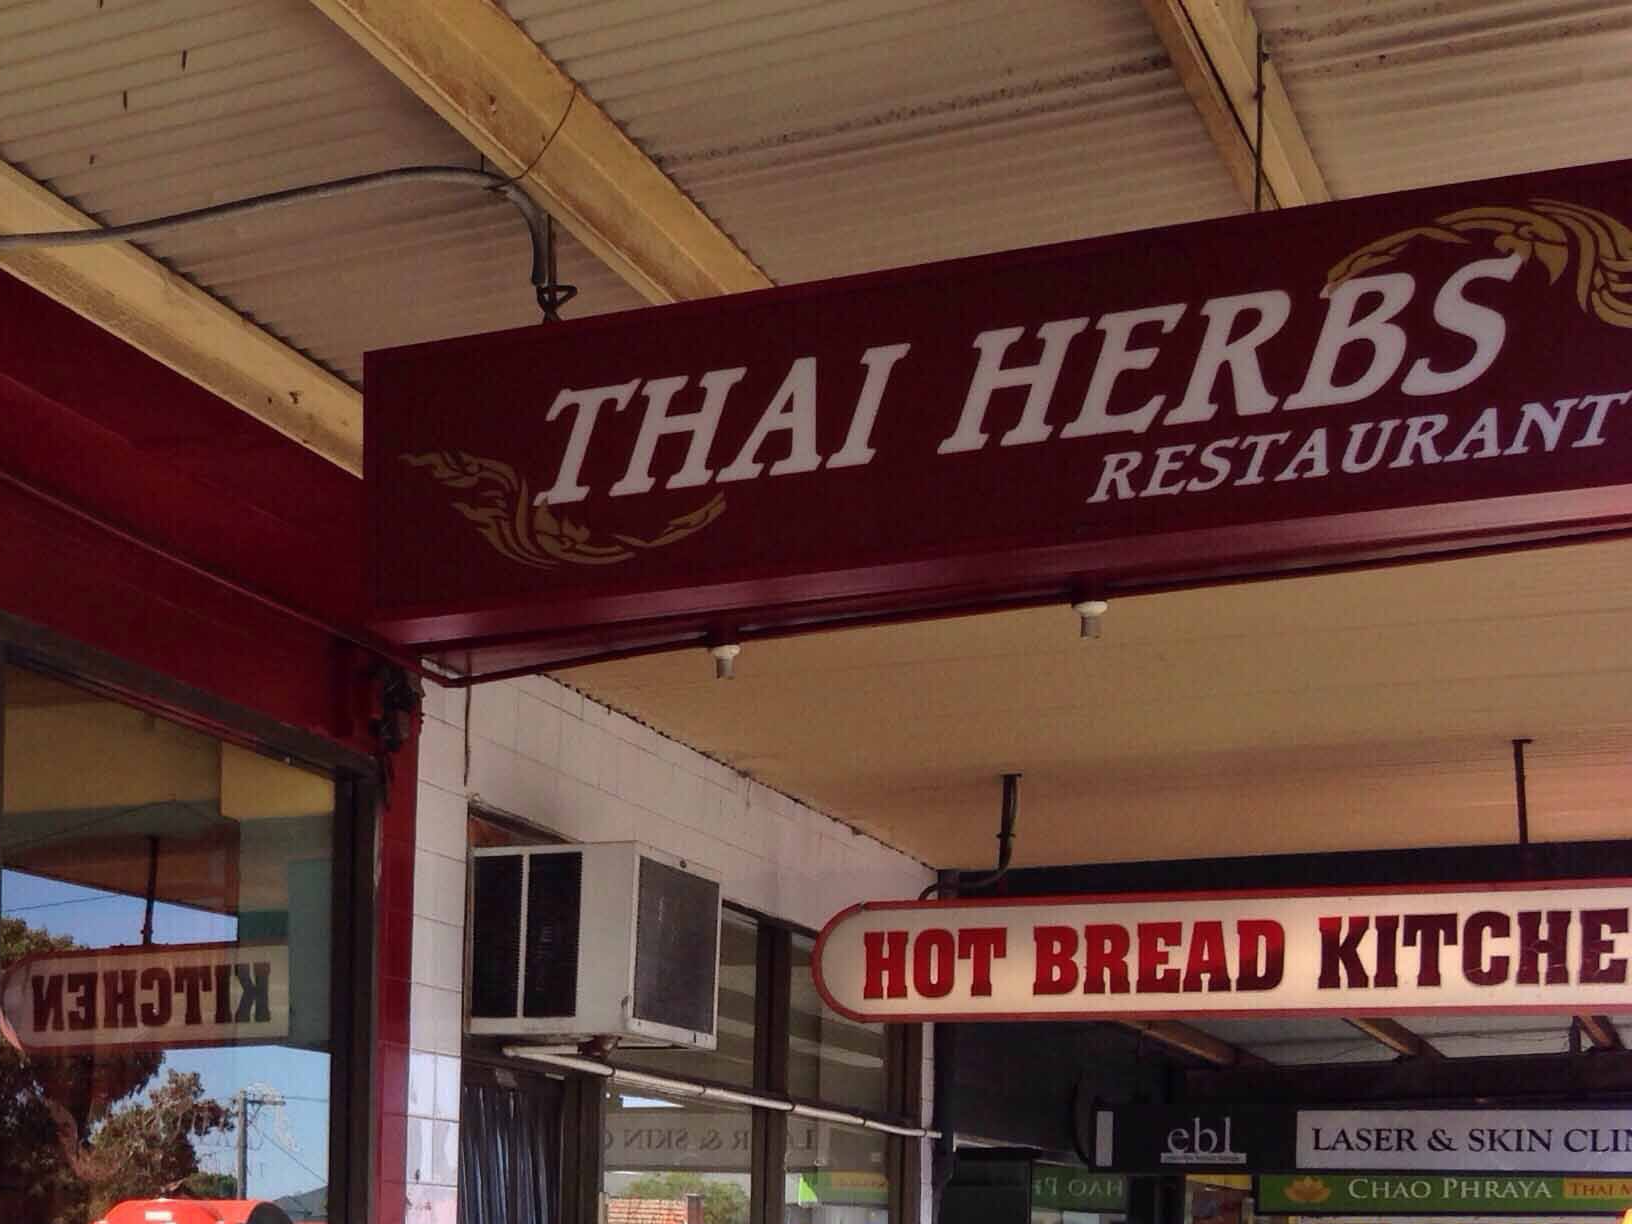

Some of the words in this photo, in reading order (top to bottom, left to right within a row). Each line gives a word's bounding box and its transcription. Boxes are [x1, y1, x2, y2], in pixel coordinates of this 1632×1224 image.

[532, 340, 913, 508] THAI
[937, 252, 1525, 454] HERBS
[1086, 389, 1632, 505] RESTAURANT
[862, 926, 1008, 1000] HOT
[1032, 918, 1287, 996] BREAD
[1312, 1128, 1419, 1152] LASER
[1427, 1128, 1458, 1152] &
[1468, 1127, 1552, 1153] SKIN
[1348, 1177, 1432, 1200] CHAO
[1442, 1176, 1553, 1199] PHRAYA
[1571, 1182, 1615, 1197] THAI
